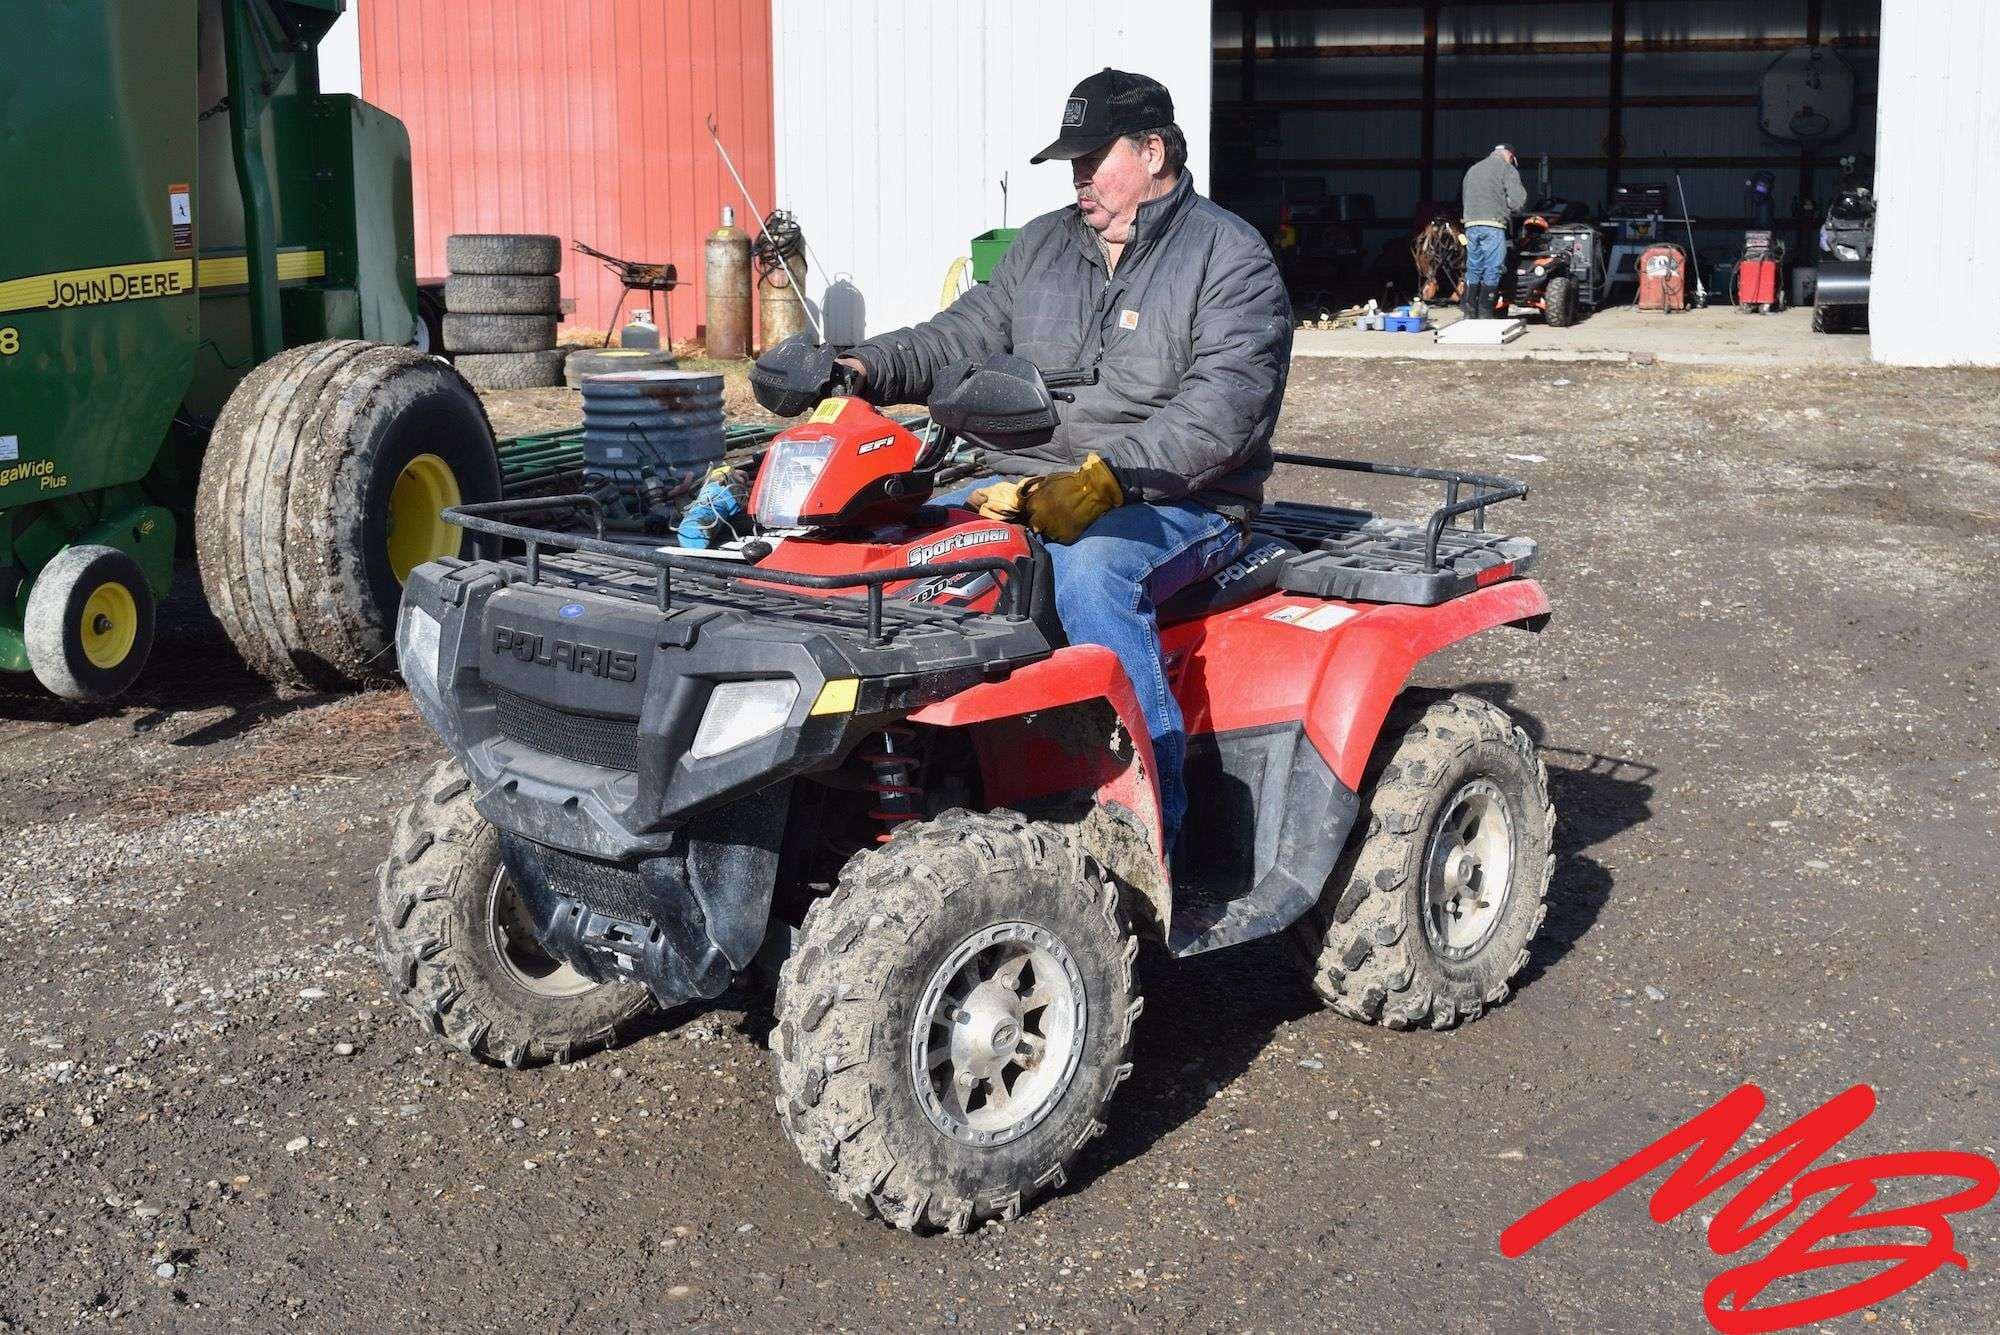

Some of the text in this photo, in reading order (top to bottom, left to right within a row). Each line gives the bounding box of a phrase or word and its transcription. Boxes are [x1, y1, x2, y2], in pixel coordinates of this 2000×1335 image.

[48, 271, 181, 307] JOHN DEERE
[857, 435, 896, 455] EFI
[40, 475, 68, 491] Plus
[908, 529, 1010, 567] Sportsman
[1213, 542, 1286, 590] POLARIS
[908, 579, 949, 604] 00
[494, 625, 637, 683] POLARIS
